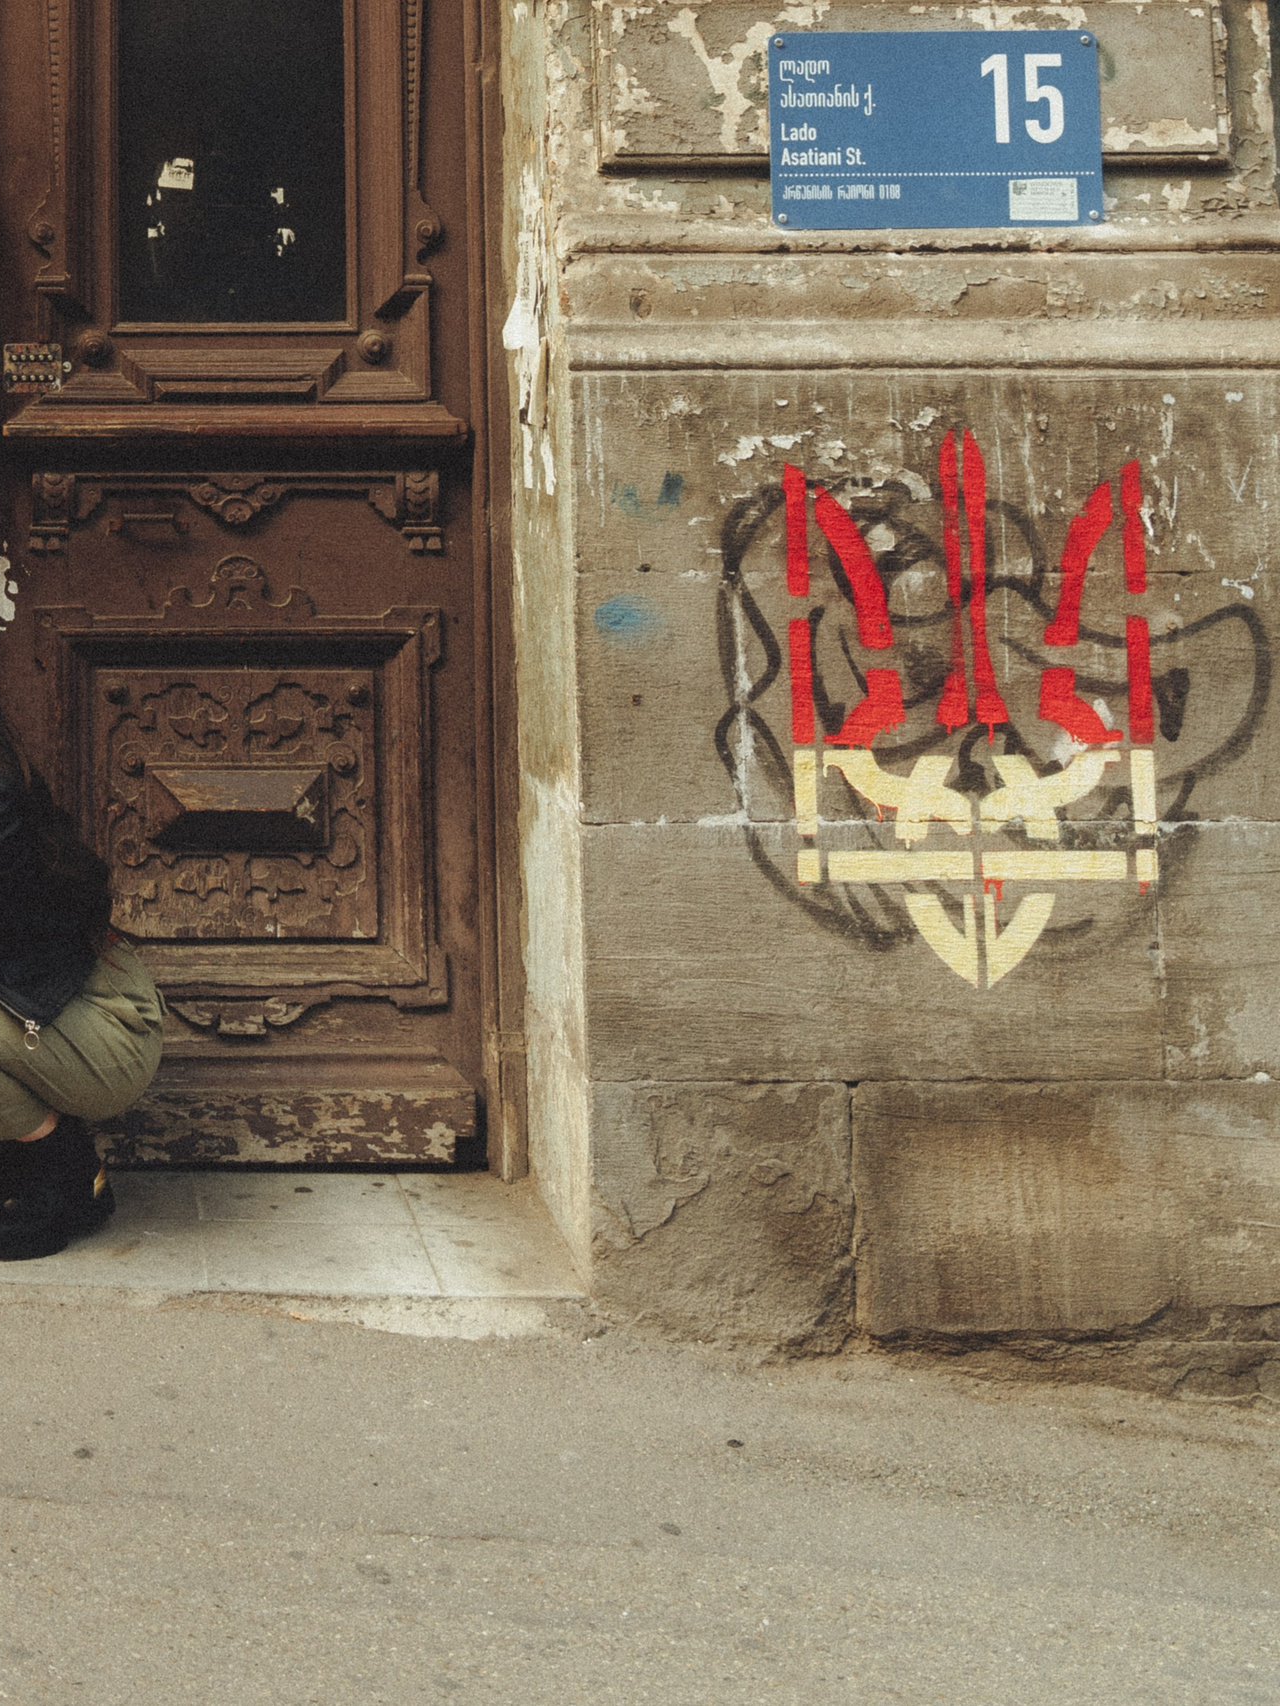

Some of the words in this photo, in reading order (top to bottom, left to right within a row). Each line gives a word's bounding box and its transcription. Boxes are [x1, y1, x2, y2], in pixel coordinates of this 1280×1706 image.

[779, 59, 830, 83] ლადო
[780, 84, 859, 108] ასათიანის
[980, 53, 1065, 144] 15
[781, 123, 817, 141] Lado
[781, 147, 842, 166] Asatiani
[845, 147, 867, 166] St.
